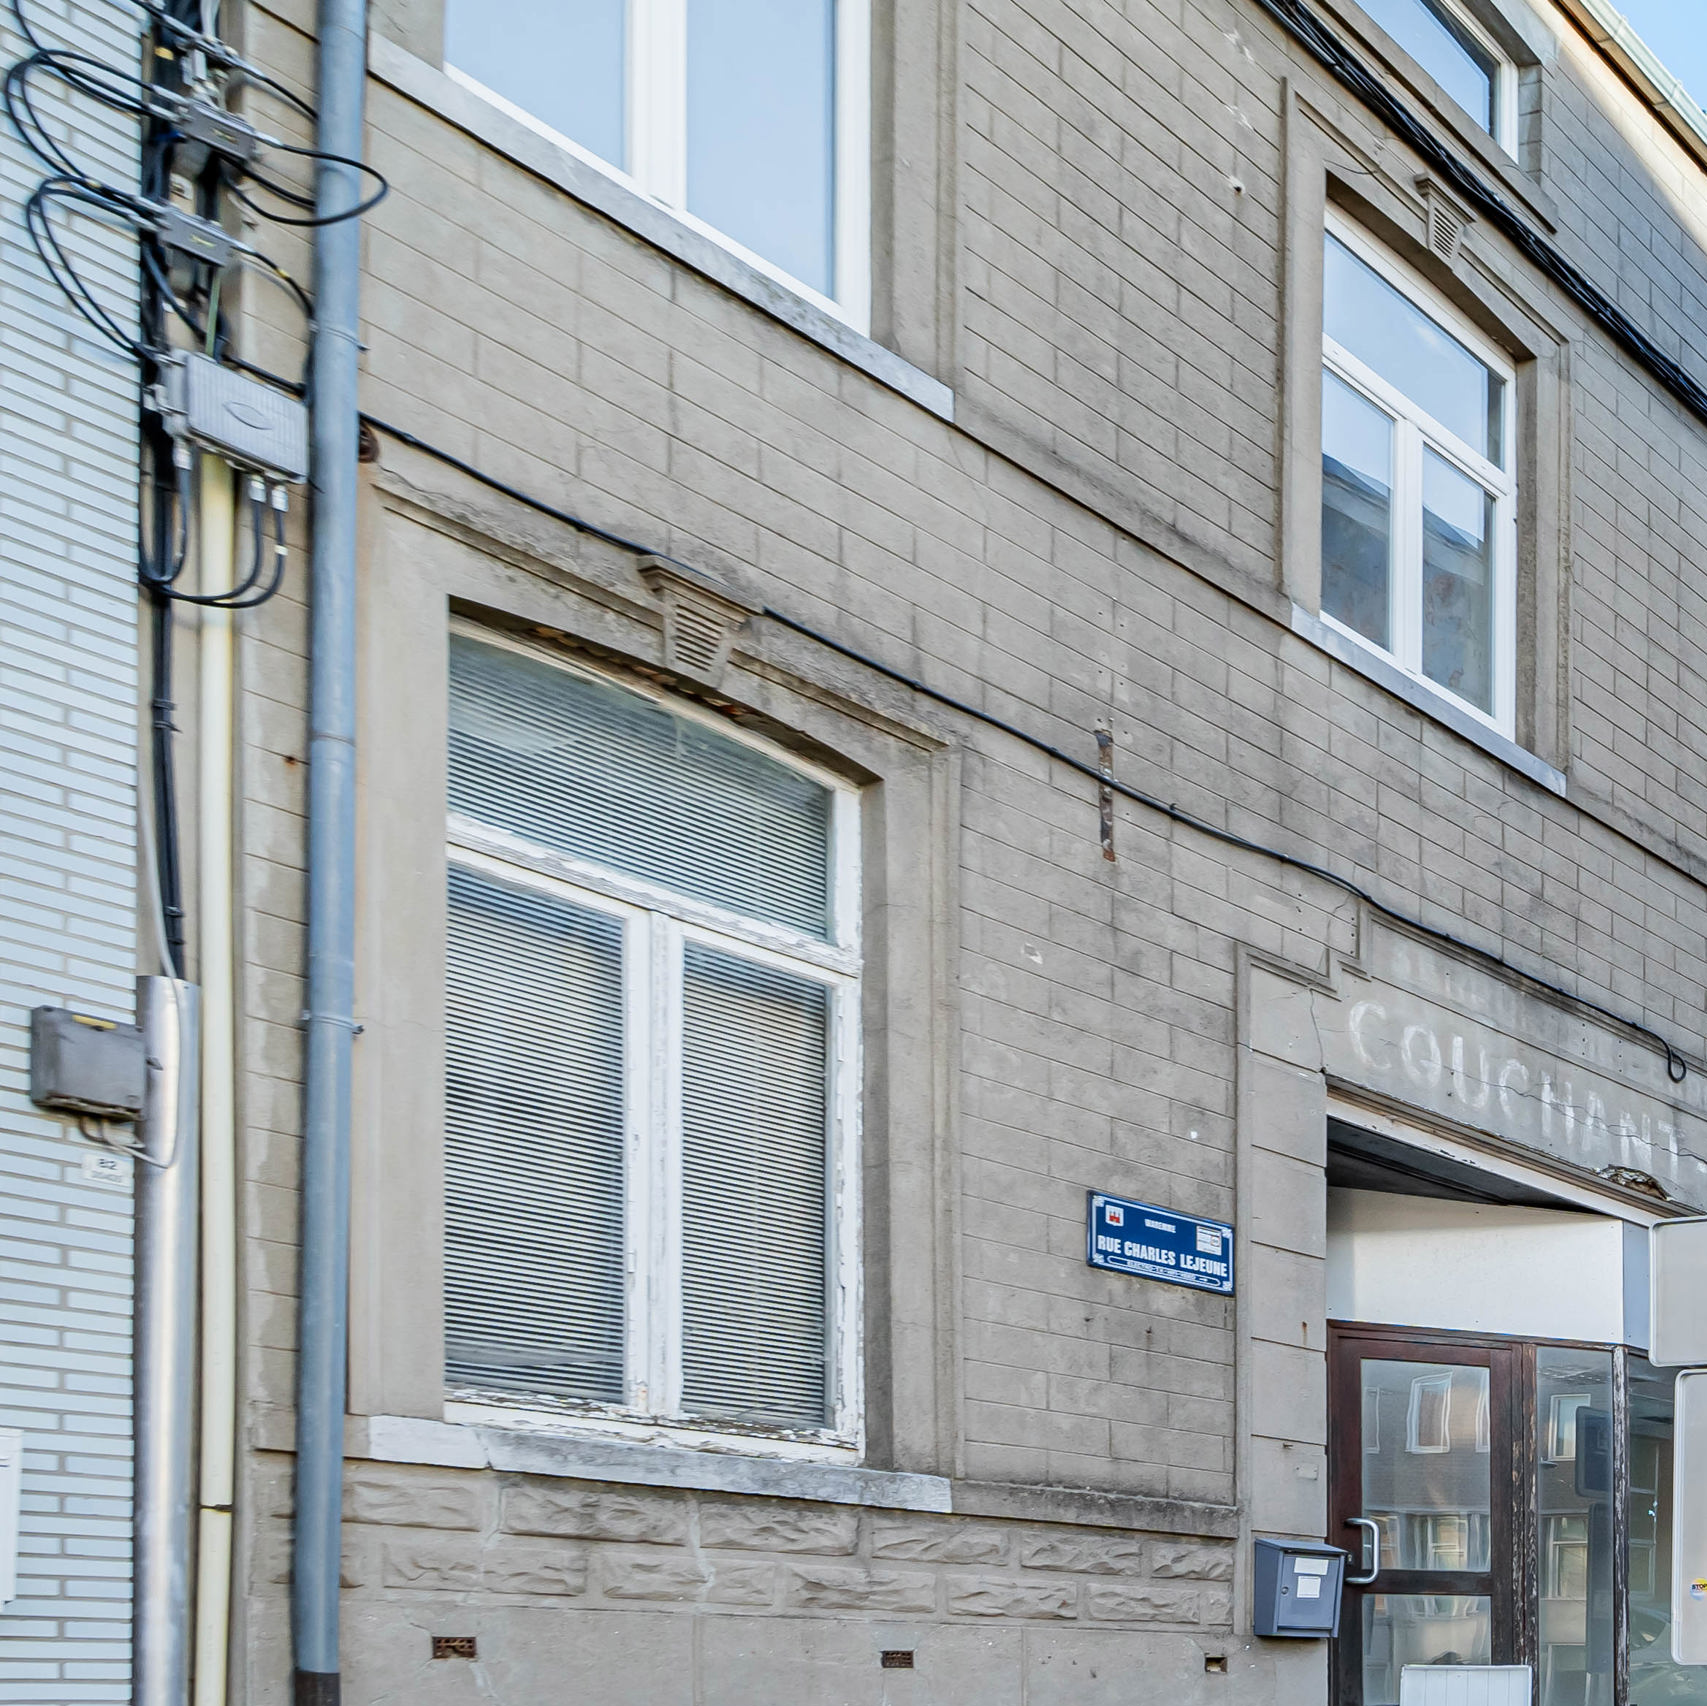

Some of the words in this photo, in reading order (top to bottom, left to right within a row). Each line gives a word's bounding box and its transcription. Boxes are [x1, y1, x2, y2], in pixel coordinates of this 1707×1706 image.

[1097, 1234, 1122, 1254] RUE
[1123, 1240, 1176, 1266] CHARLES
[1180, 1253, 1228, 1277] LEJEUNE
